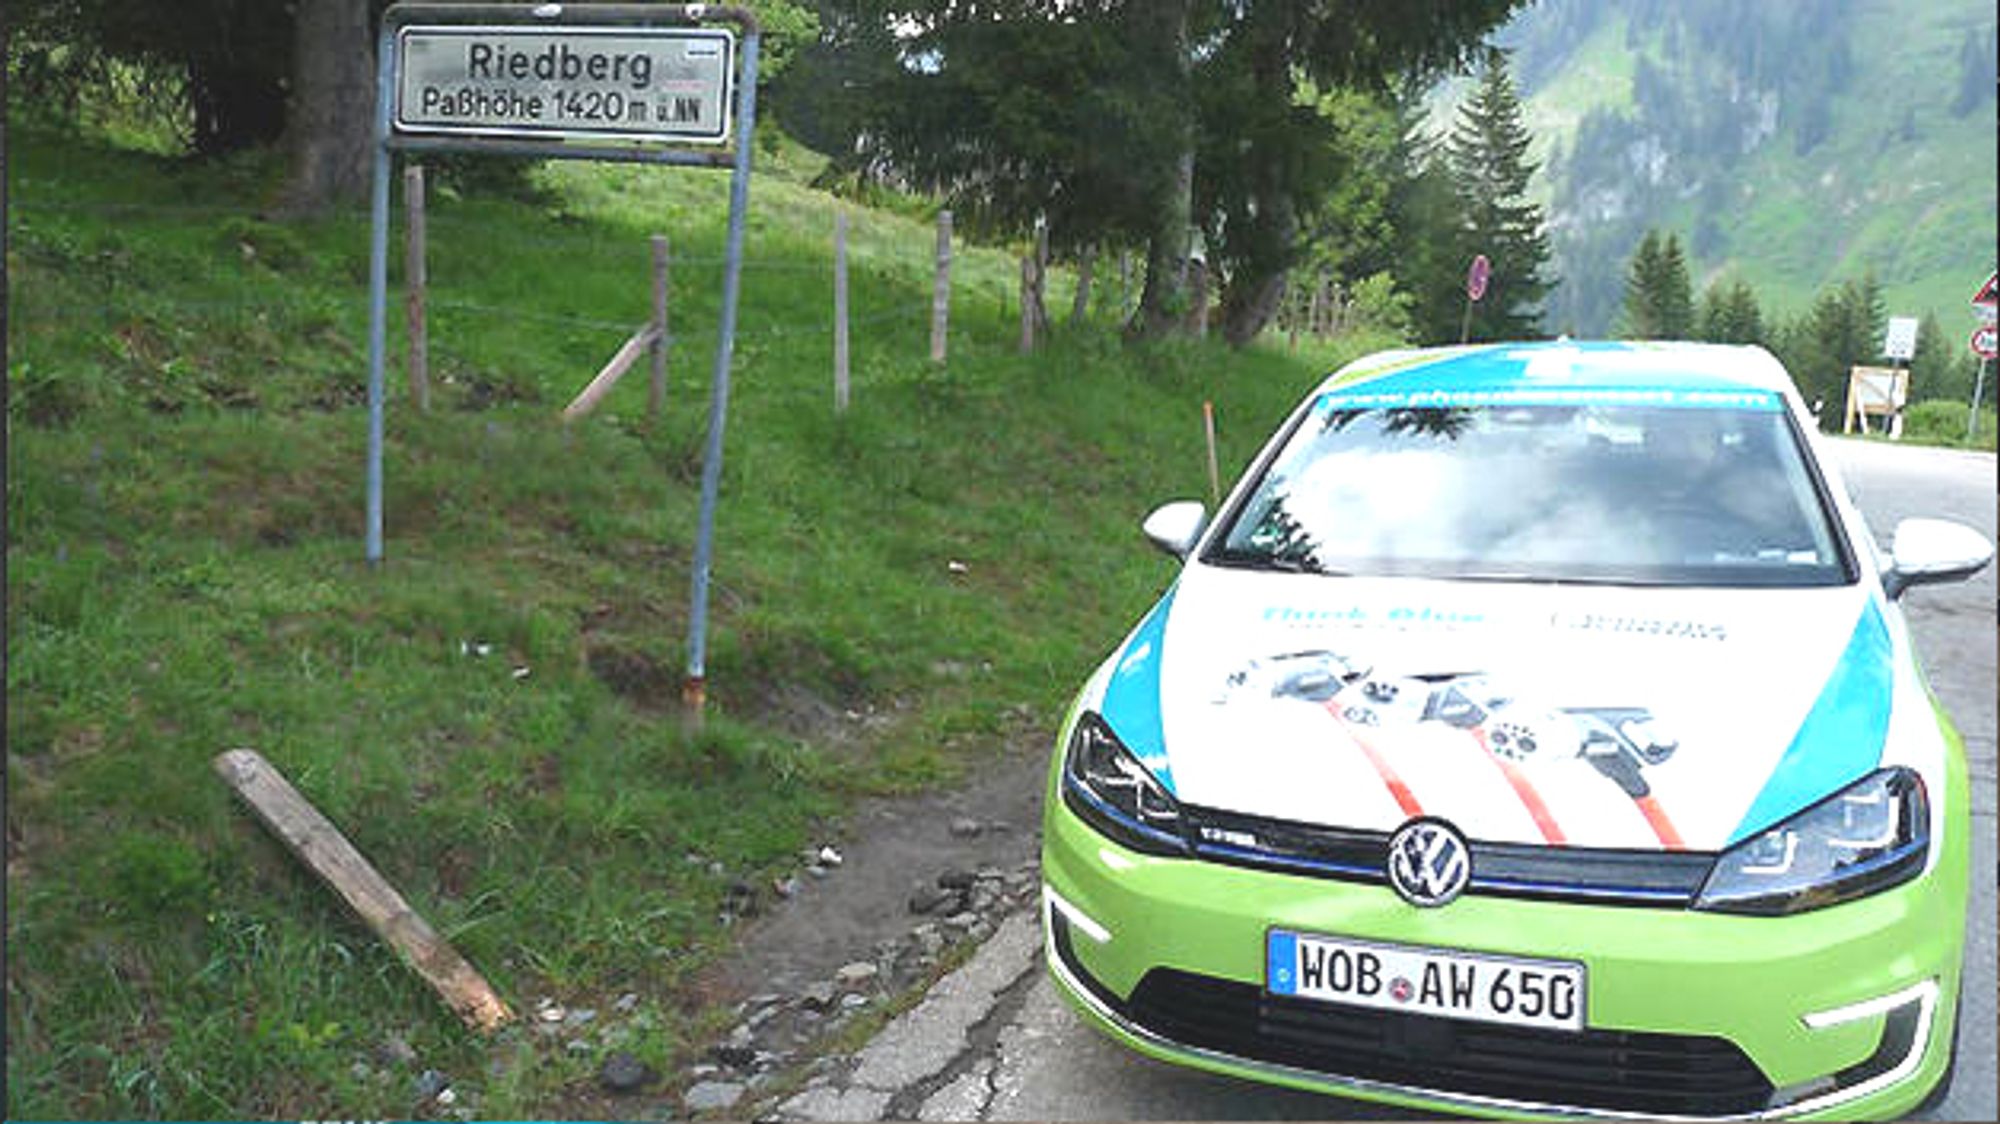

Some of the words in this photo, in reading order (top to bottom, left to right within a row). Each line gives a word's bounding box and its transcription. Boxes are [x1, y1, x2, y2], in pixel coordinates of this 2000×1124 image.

[468, 43, 653, 89] Riedberg
[421, 85, 544, 120] Paßhöhe
[552, 90, 623, 121] 1420
[1300, 944, 1383, 997] WOB
[1418, 961, 1476, 1009] AW
[1489, 967, 1575, 1021] 650
